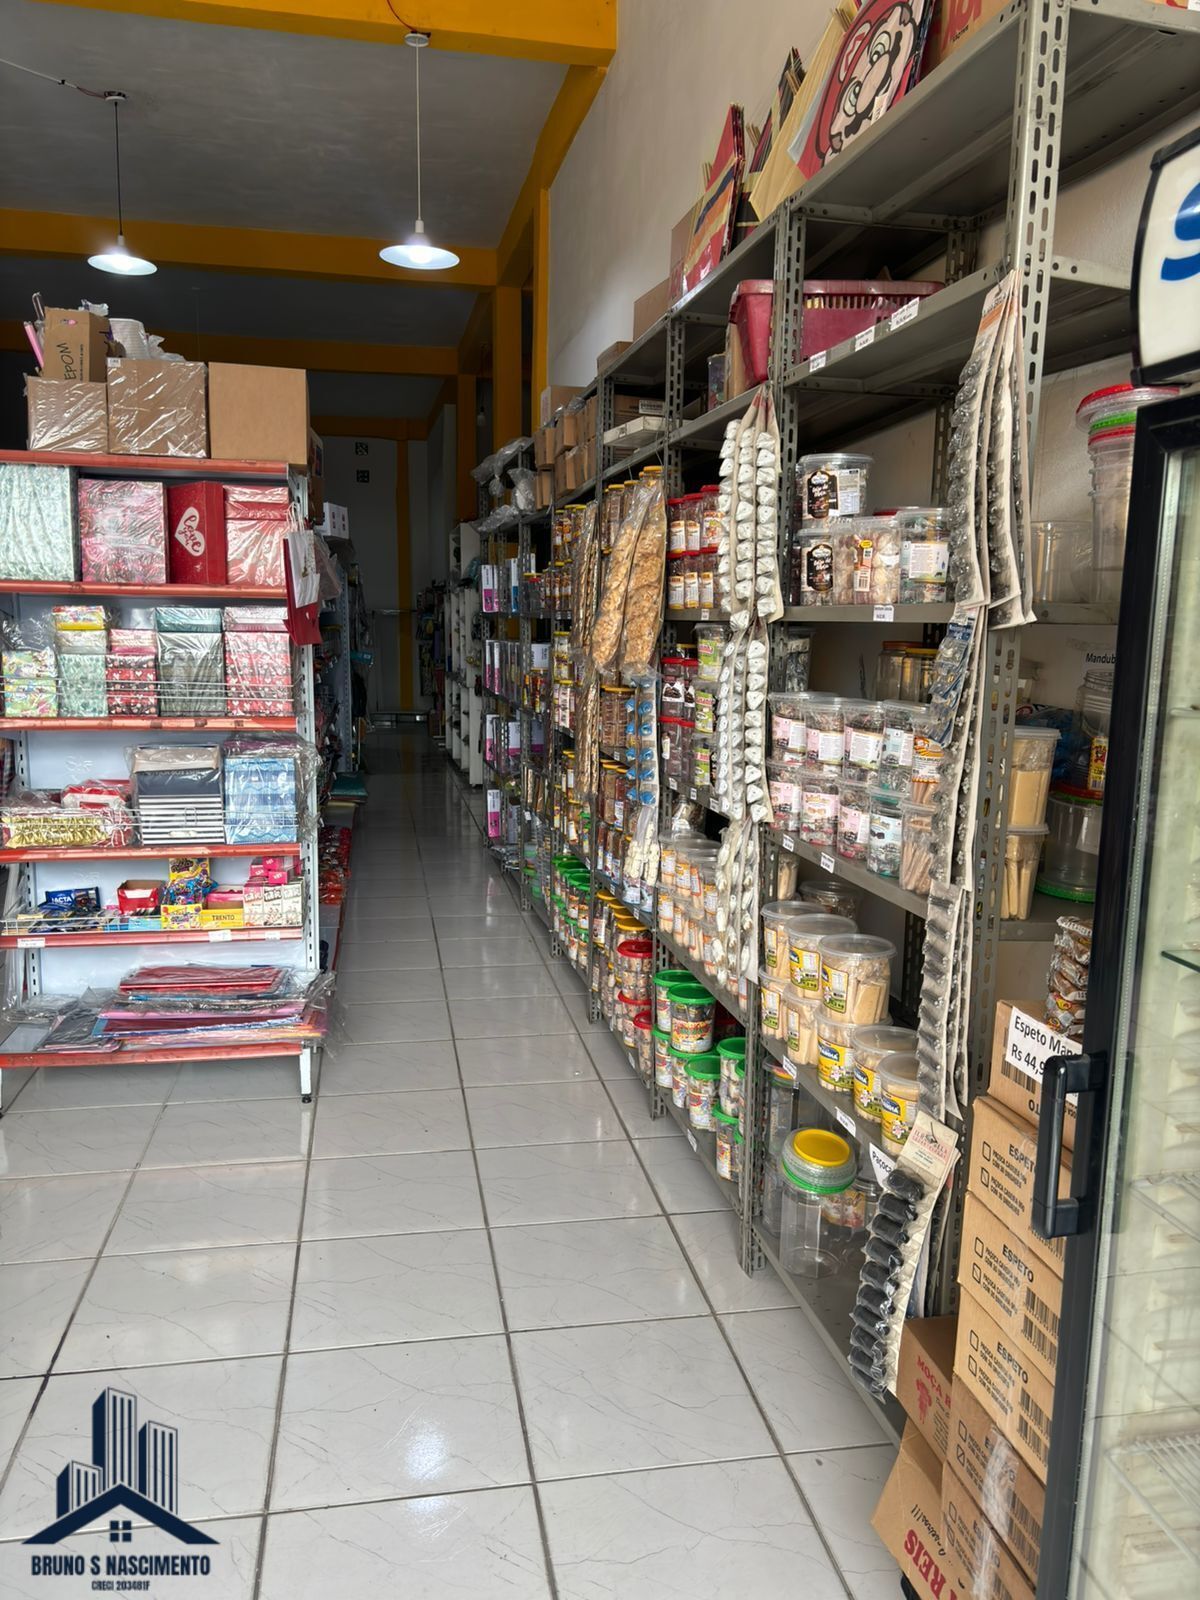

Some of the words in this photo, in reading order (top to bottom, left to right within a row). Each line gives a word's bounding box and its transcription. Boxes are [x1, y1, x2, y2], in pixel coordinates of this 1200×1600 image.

[1014, 1015, 1047, 1046] Espeto
[1002, 1244, 1035, 1283] ESPETO
[997, 1341, 1029, 1384] ESPETO
[904, 1529, 947, 1600] REIS
